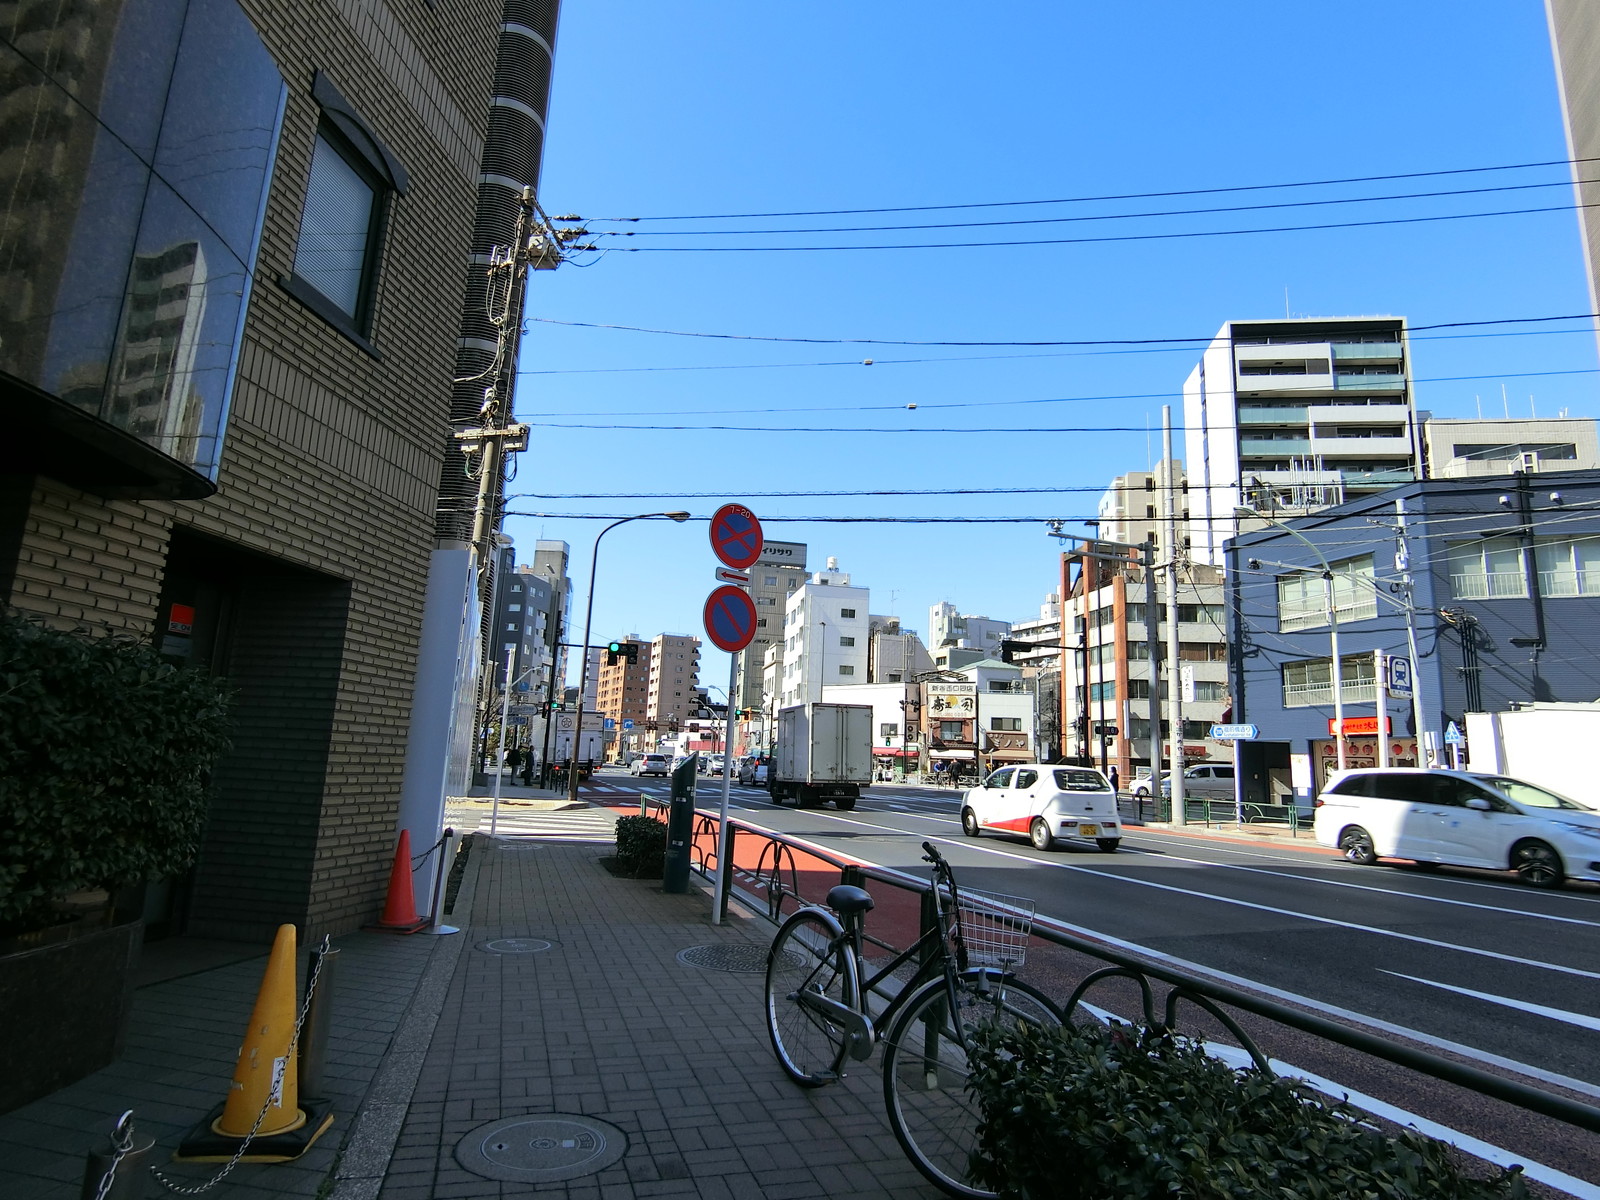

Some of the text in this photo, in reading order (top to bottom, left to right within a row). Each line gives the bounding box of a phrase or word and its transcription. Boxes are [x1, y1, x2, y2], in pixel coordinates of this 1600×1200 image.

[730, 506, 750, 519] 7-20
[762, 547, 792, 557] イリサワ
